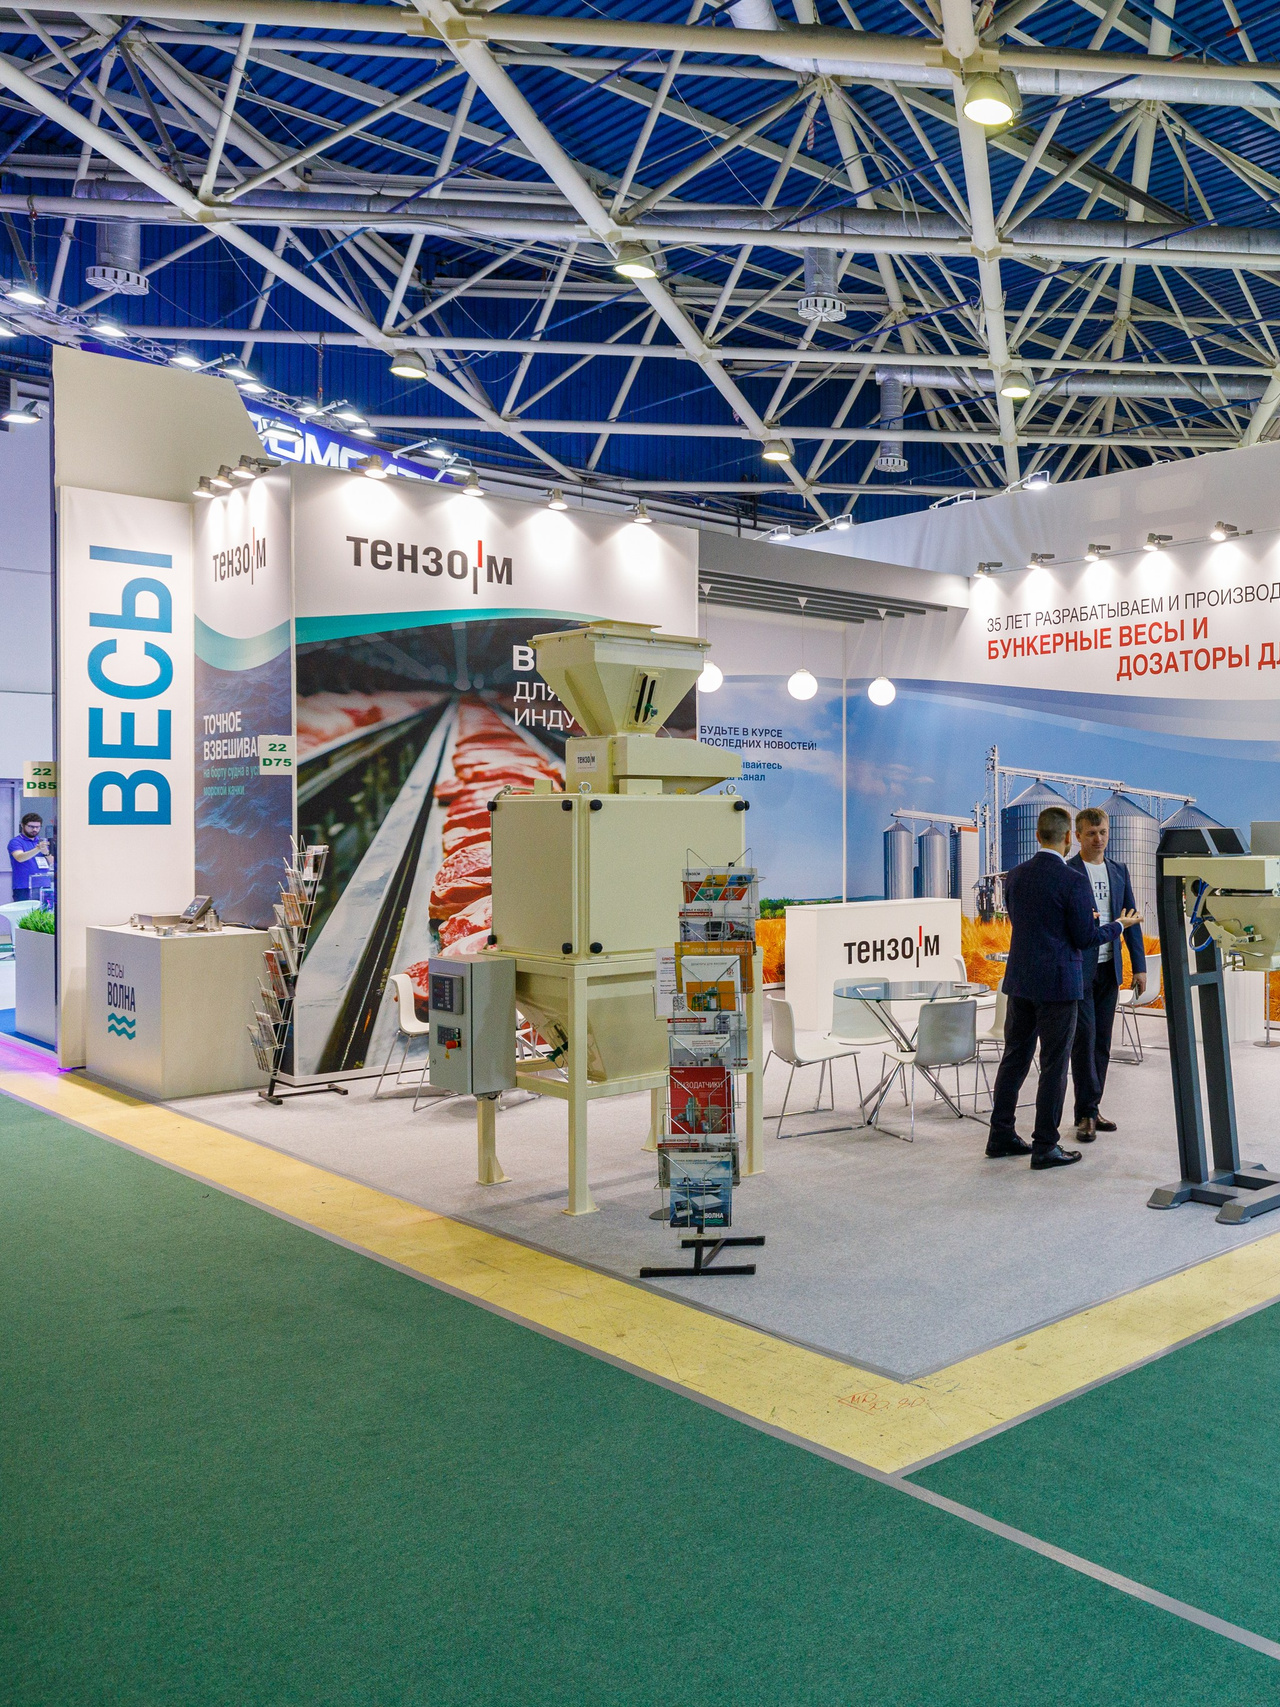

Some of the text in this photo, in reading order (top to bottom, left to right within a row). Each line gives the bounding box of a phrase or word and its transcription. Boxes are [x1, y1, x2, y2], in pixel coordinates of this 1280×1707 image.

[987, 617, 1002, 633] 35
[1005, 612, 1031, 631] ЛЕТ
[1035, 596, 1163, 627] РАЗРАБАТЫВАЕМ
[1168, 595, 1179, 612] И
[988, 617, 1208, 660] БУНКЕРНЫЕ ВЕСЫ И
[1117, 645, 1250, 681] ДОЗАТОРЫ
[88, 545, 173, 825] ВЕСЫ
[203, 711, 242, 735] ТОЧНОЕ
[514, 708, 576, 731] ИНДУ
[700, 725, 782, 738] БУДЬТЕ В КУРСЕ
[203, 736, 260, 761] ВЗВЕШИВА
[268, 743, 287, 752] 22
[700, 737, 817, 751] ПОСЛЕДНИХ НОВОСТЕЙ!
[32, 768, 52, 776] 22
[262, 758, 292, 767] D75
[26, 781, 57, 790] D85
[107, 962, 124, 979] ВЕСЫ
[107, 981, 136, 1013] ВОЛНА
